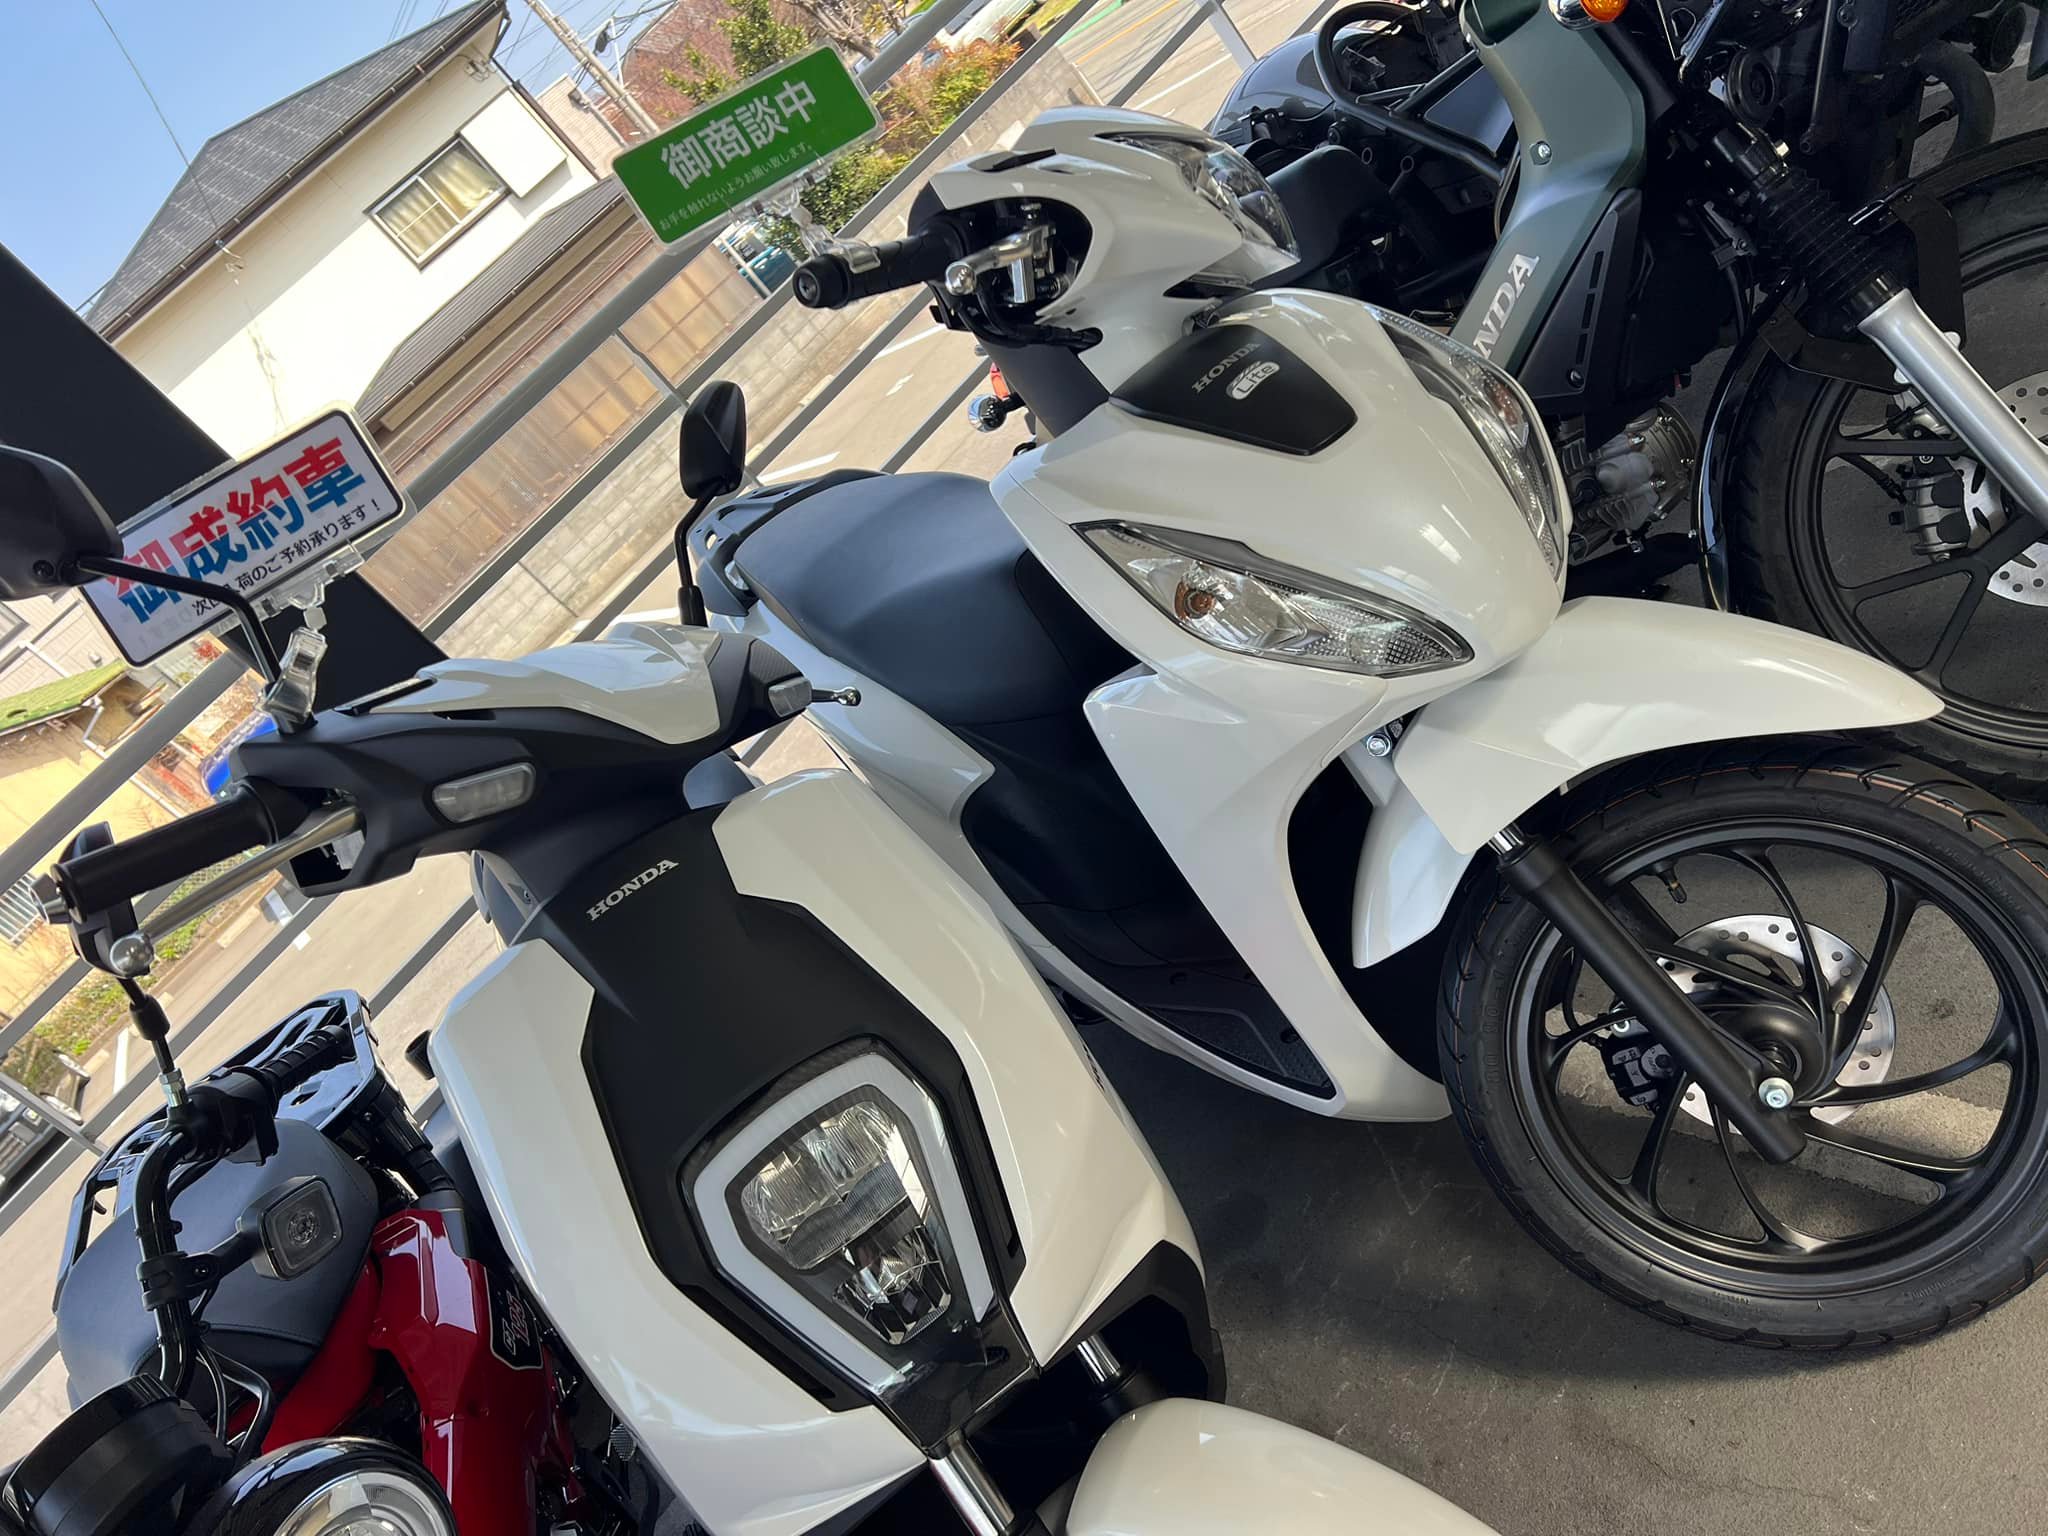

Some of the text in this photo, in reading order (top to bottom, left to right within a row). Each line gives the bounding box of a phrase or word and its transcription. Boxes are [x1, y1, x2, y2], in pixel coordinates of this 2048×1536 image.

[660, 78, 817, 190] 御商談中
[1191, 342, 1261, 394] HONDA
[1234, 363, 1277, 397] Lite
[191, 498, 381, 617] 次荷のご予約承ります！
[586, 859, 680, 921] HONDA
